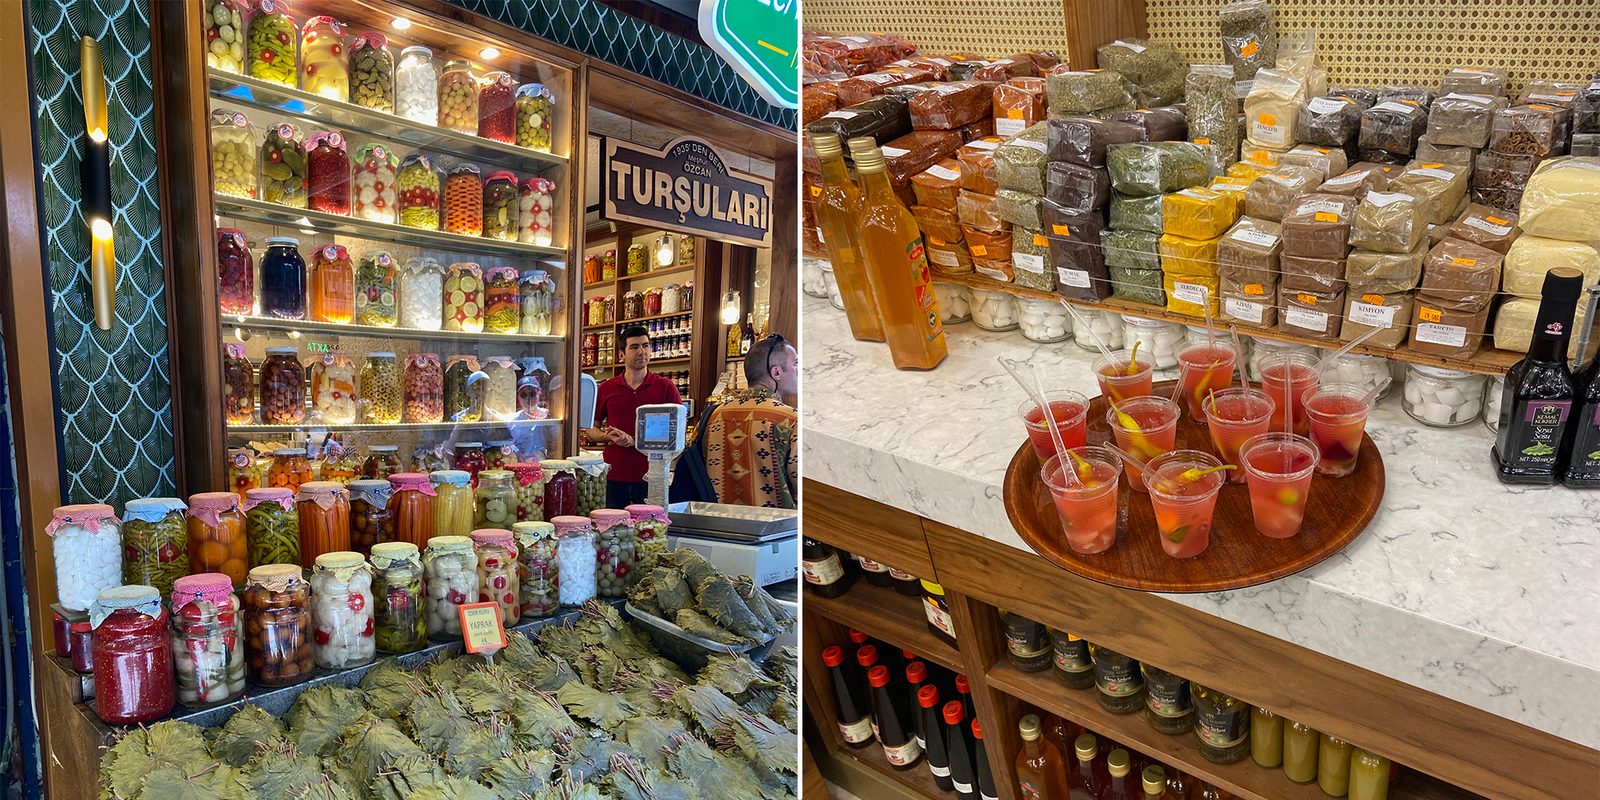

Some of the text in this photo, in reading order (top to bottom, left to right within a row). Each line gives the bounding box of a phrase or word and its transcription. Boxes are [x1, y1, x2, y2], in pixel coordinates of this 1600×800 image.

[692, 143, 708, 157] DEN
[683, 160, 712, 178] ÖZCAN
[611, 160, 767, 230] TURŞULARI
[1358, 304, 1386, 315] KİMYON
[469, 620, 493, 630] YAPRAK
